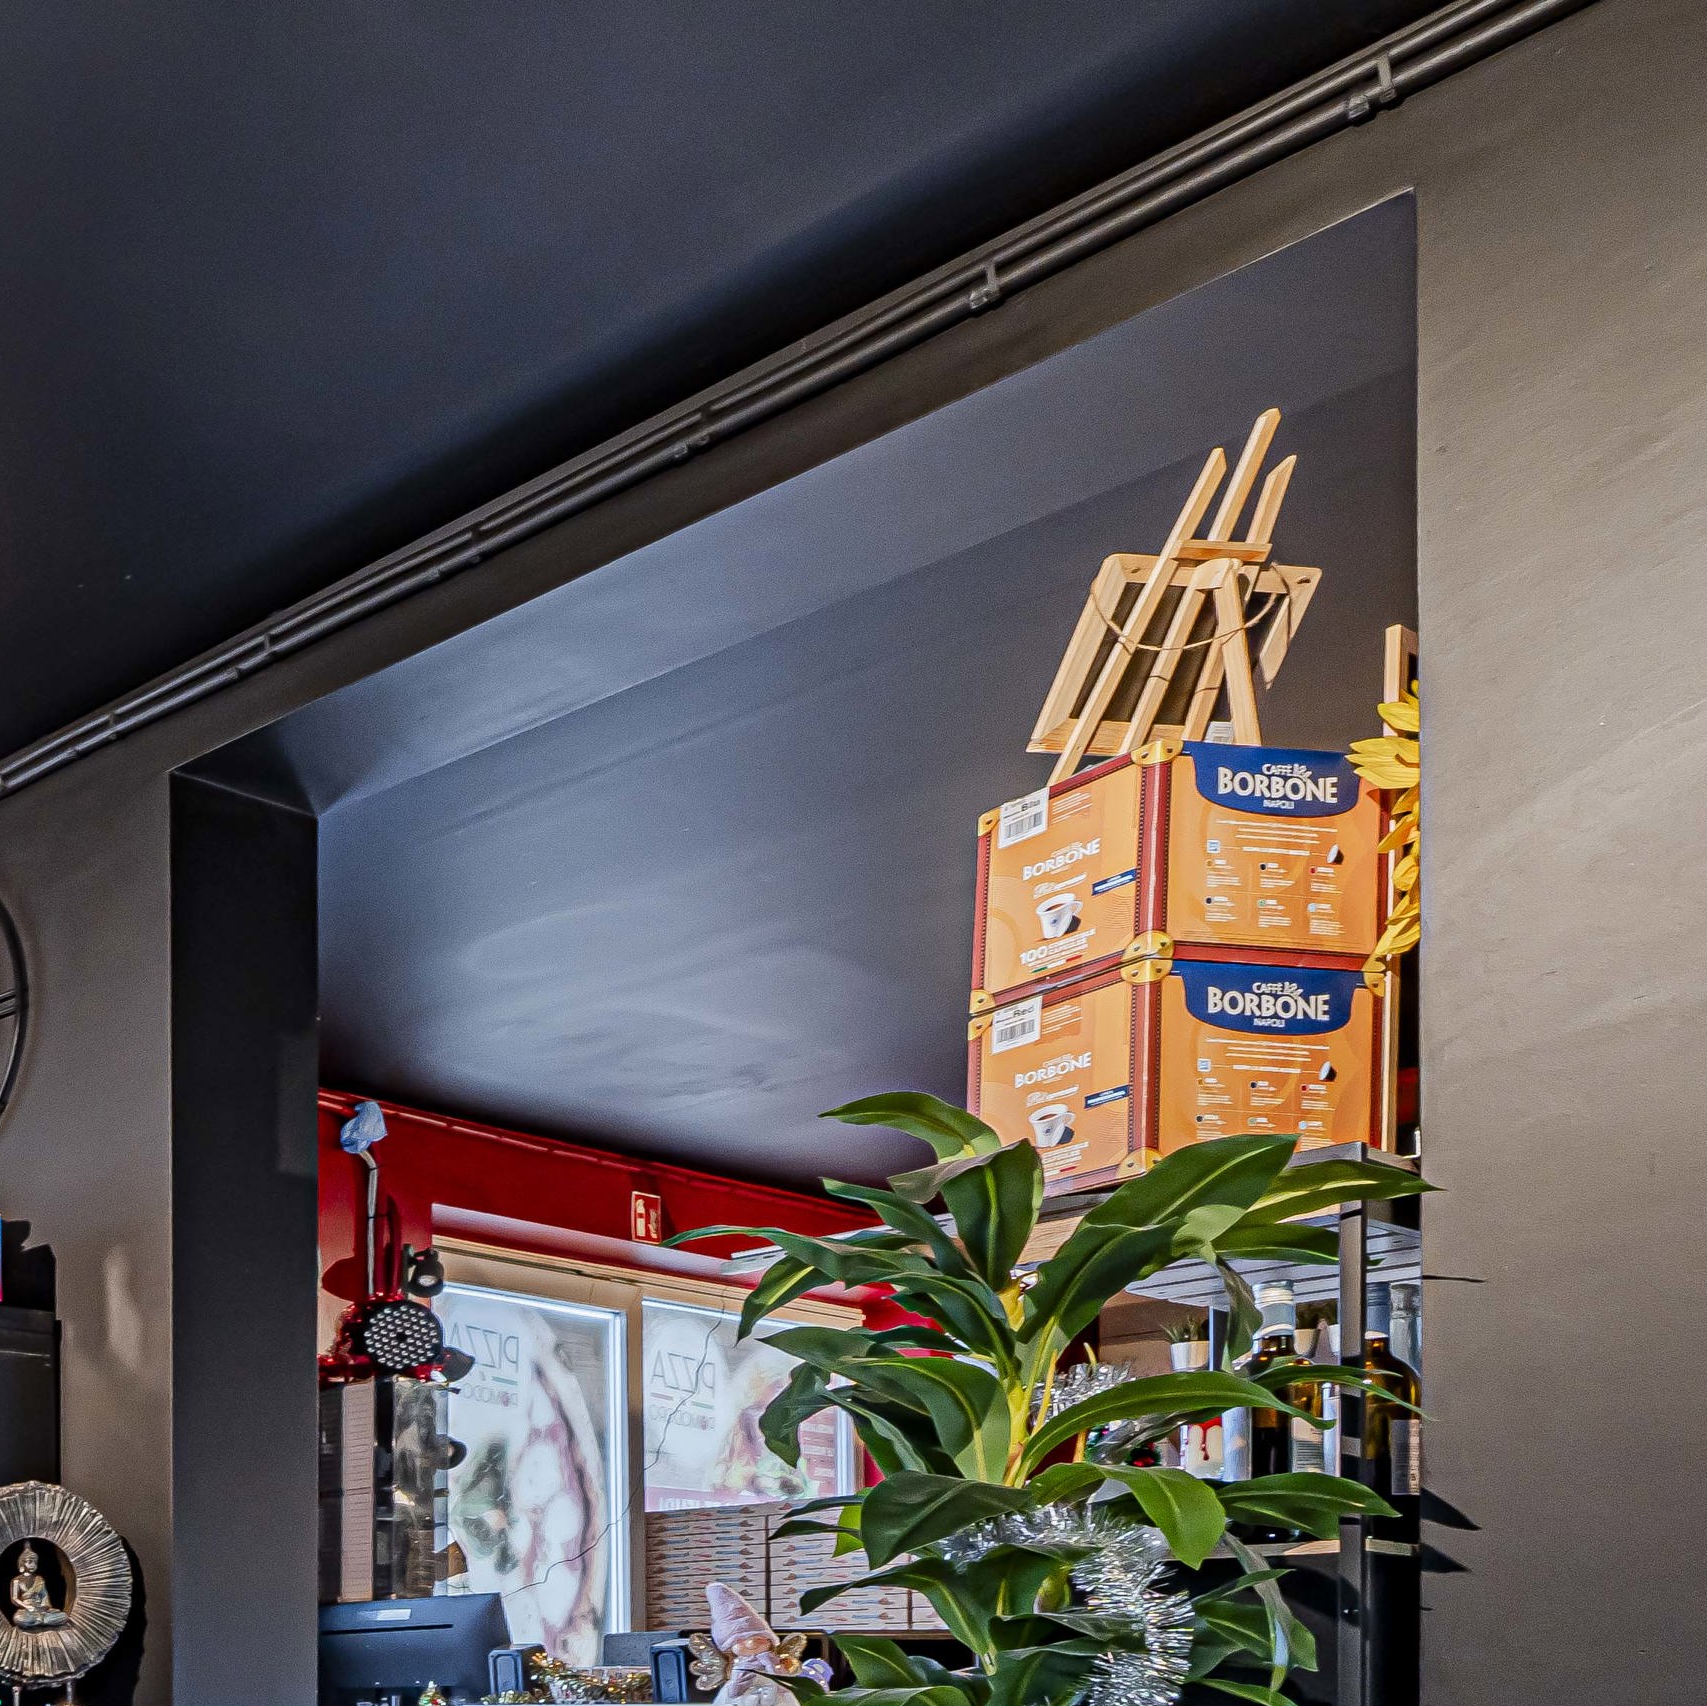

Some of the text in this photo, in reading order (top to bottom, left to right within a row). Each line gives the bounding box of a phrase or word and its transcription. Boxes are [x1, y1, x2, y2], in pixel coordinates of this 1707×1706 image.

[1217, 767, 1338, 803] BORBONE
[1022, 838, 1100, 880] BORBONE
[1020, 945, 1048, 965] 100
[1207, 986, 1330, 1021] BORBONE
[1015, 1052, 1092, 1088] BORBONE
